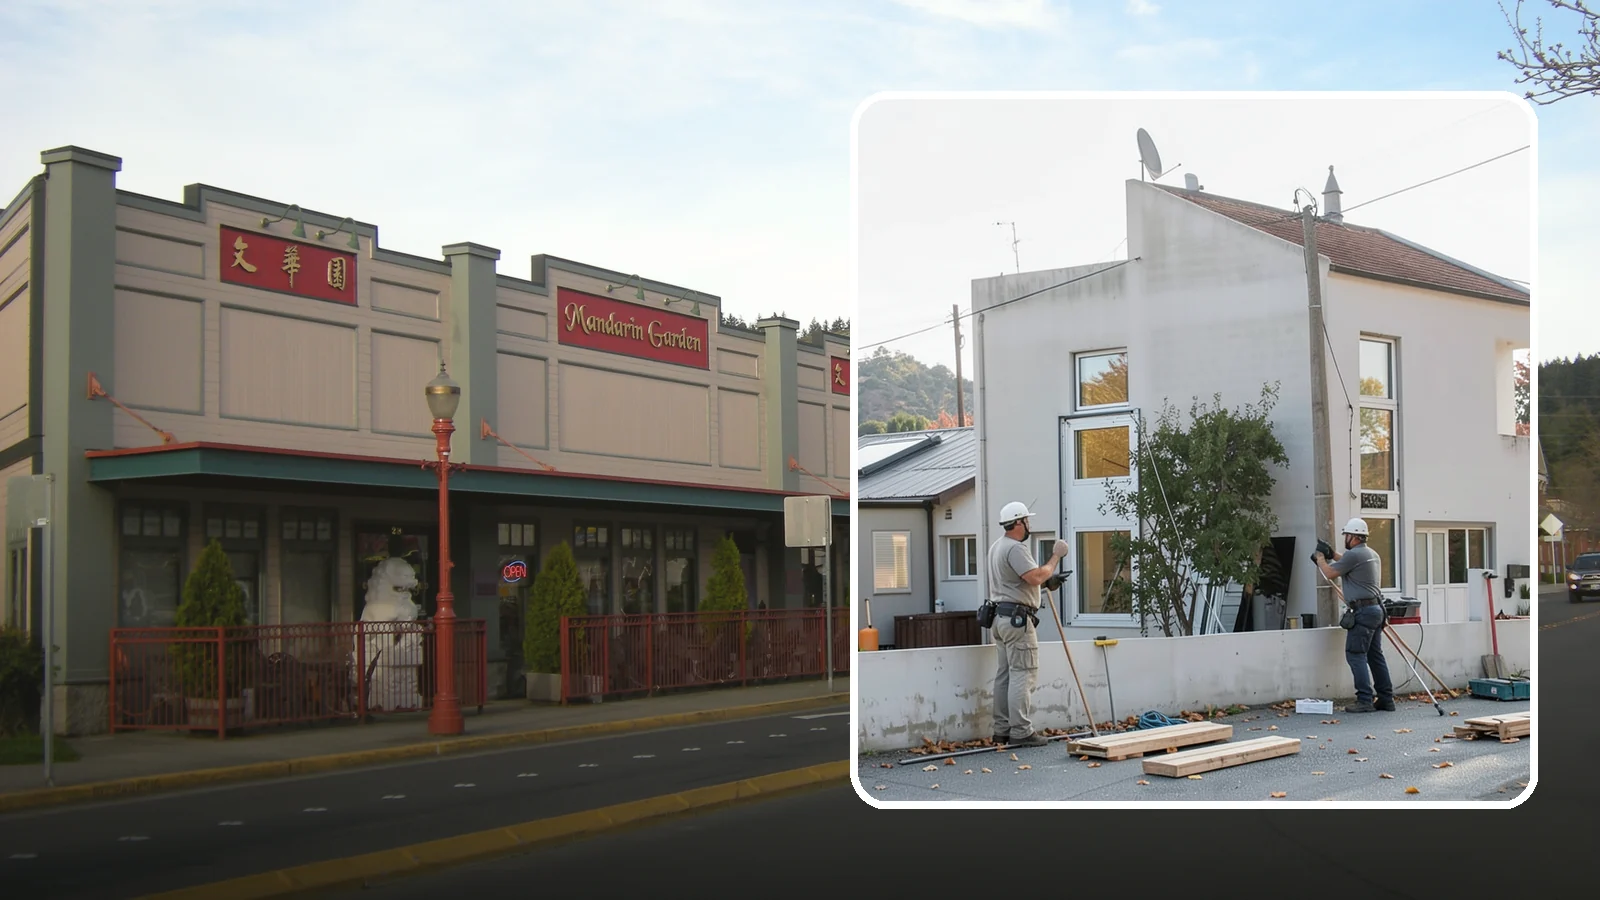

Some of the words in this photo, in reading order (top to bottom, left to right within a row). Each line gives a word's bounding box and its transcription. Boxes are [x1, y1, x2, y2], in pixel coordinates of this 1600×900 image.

[230, 235, 346, 290] 文華園
[564, 302, 644, 341] Mandarin
[648, 320, 701, 352] Garden
[503, 565, 527, 578] OPEN
